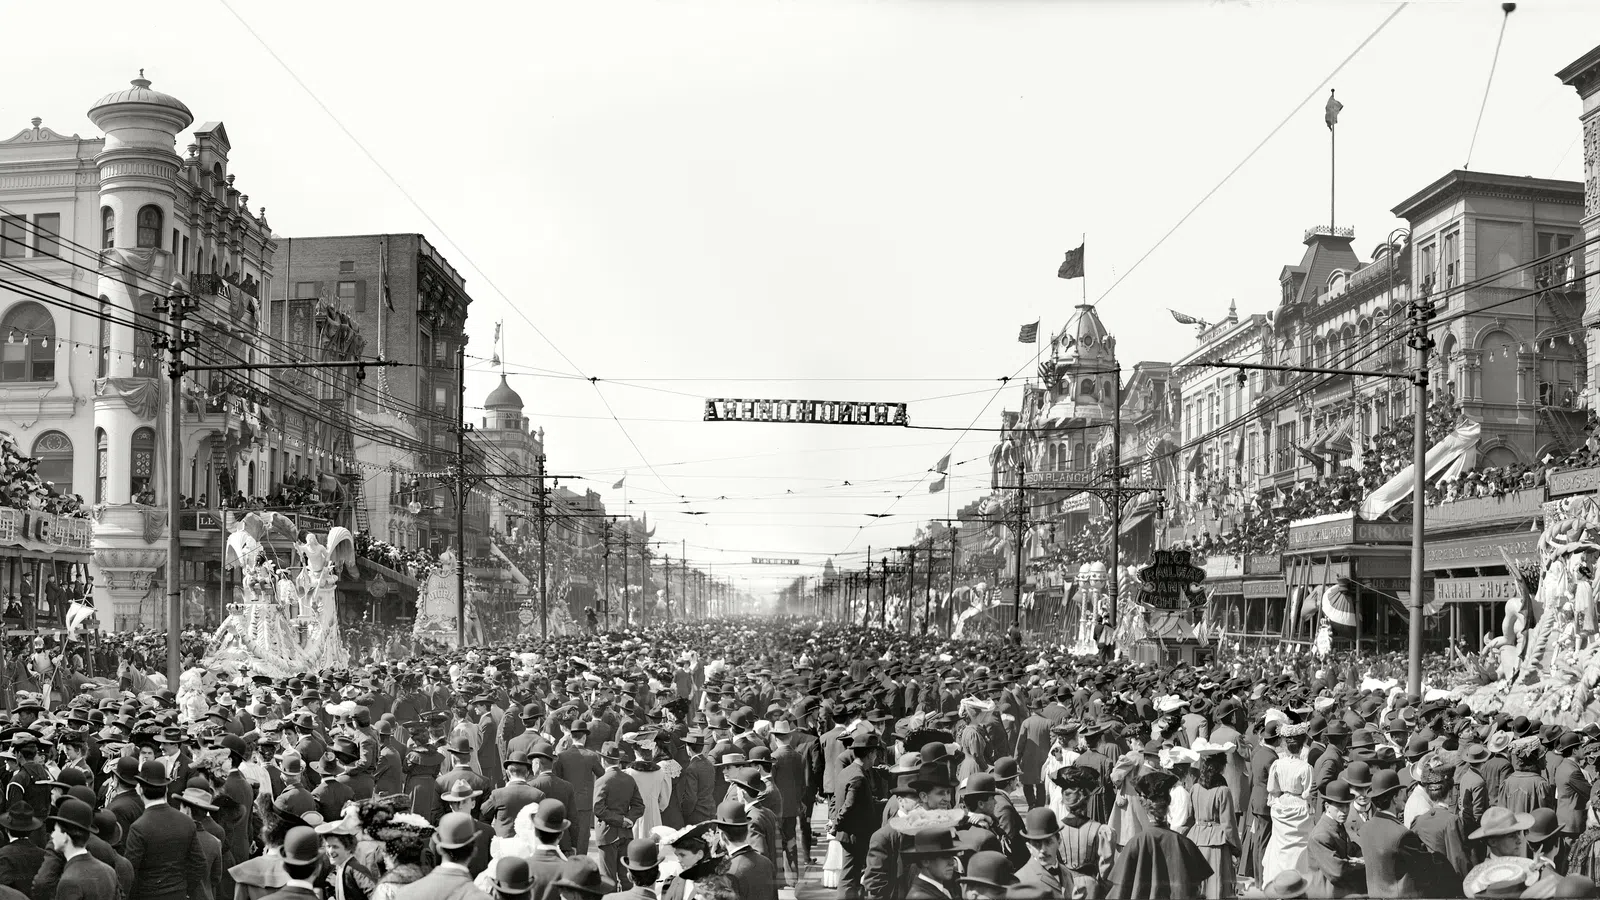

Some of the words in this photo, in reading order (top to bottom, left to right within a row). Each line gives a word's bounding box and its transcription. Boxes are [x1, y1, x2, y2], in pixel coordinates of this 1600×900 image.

[1359, 525, 1413, 539] CHICAG
[1144, 565, 1204, 582] RAILWAY
[1157, 581, 1188, 593] AND
[1438, 582, 1472, 599] HANAN
[1479, 581, 1517, 598] SHOES
